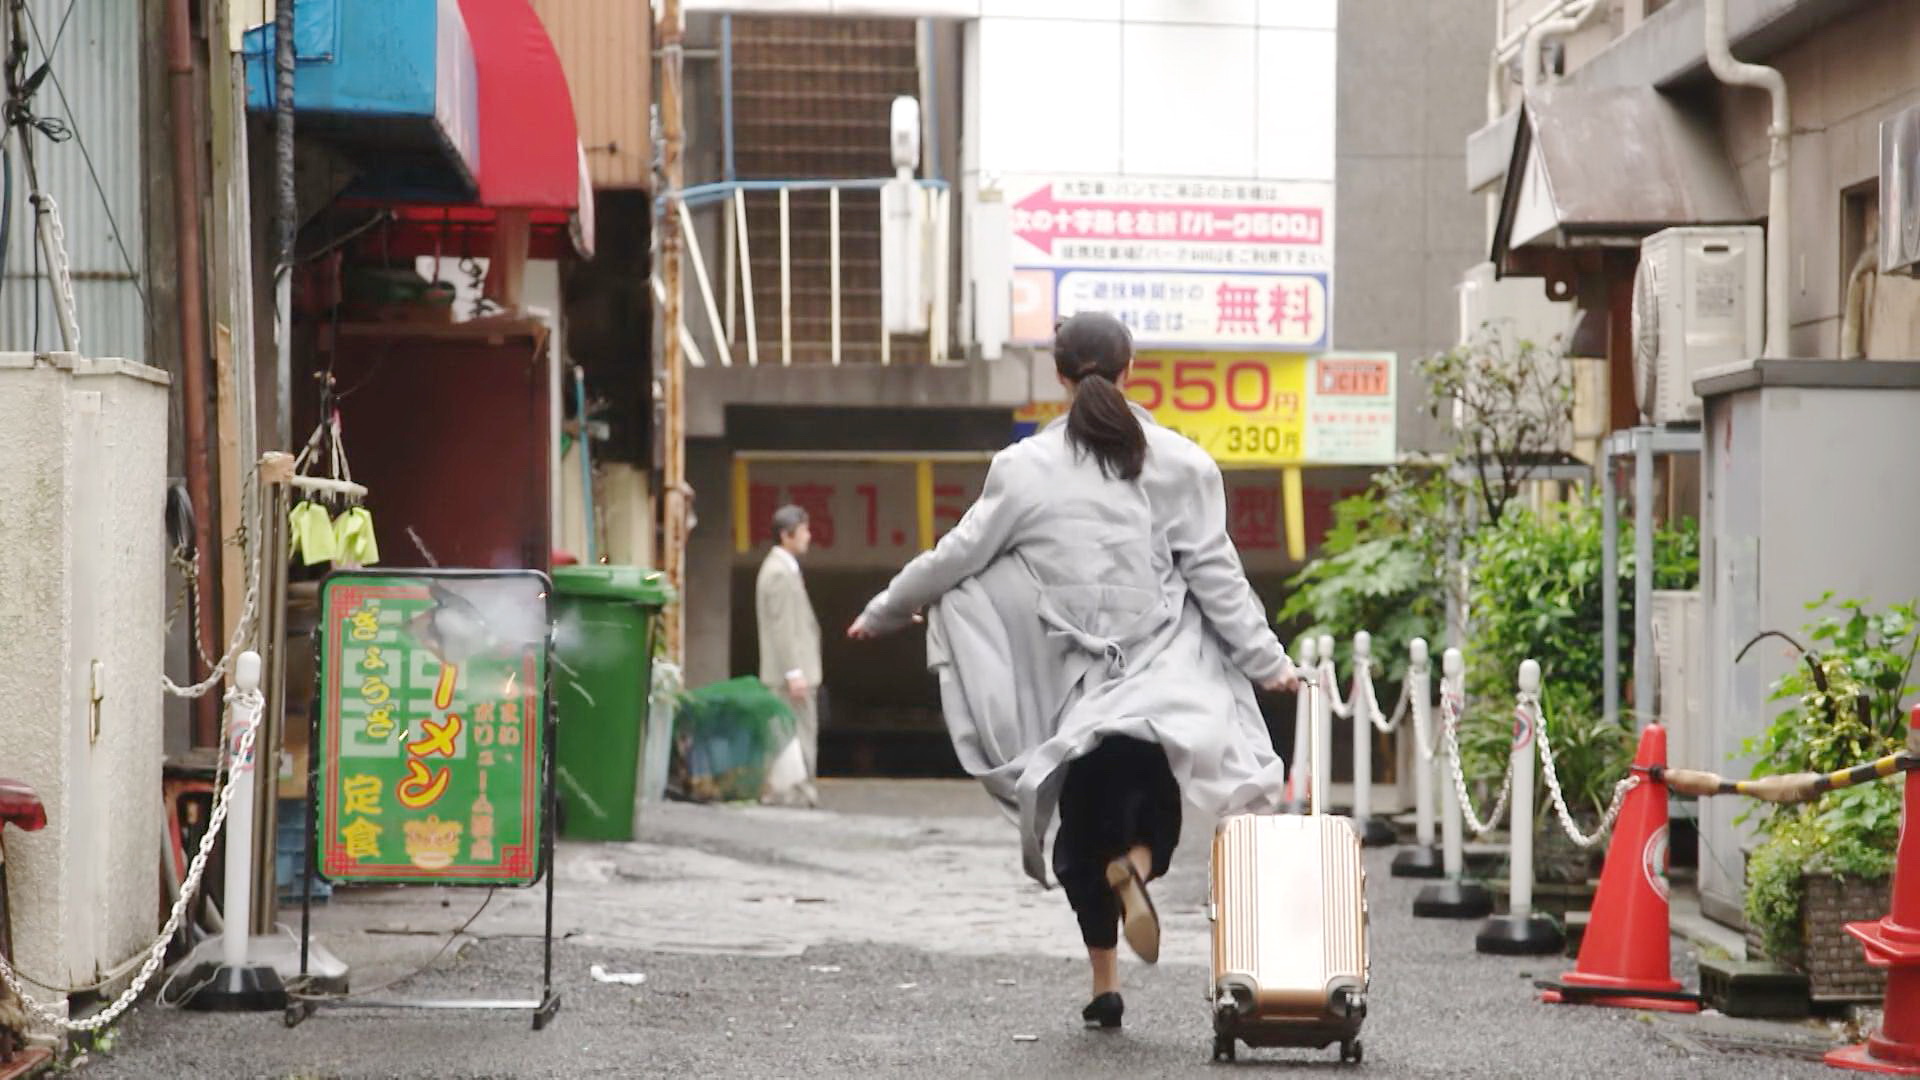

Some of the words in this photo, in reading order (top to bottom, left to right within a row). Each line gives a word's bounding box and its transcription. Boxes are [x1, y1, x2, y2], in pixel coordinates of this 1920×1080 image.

[1215, 282, 1313, 335] 無料
[351, 608, 396, 738] ぎょうざ
[396, 661, 462, 809] ーメン
[341, 773, 384, 859] 定食
